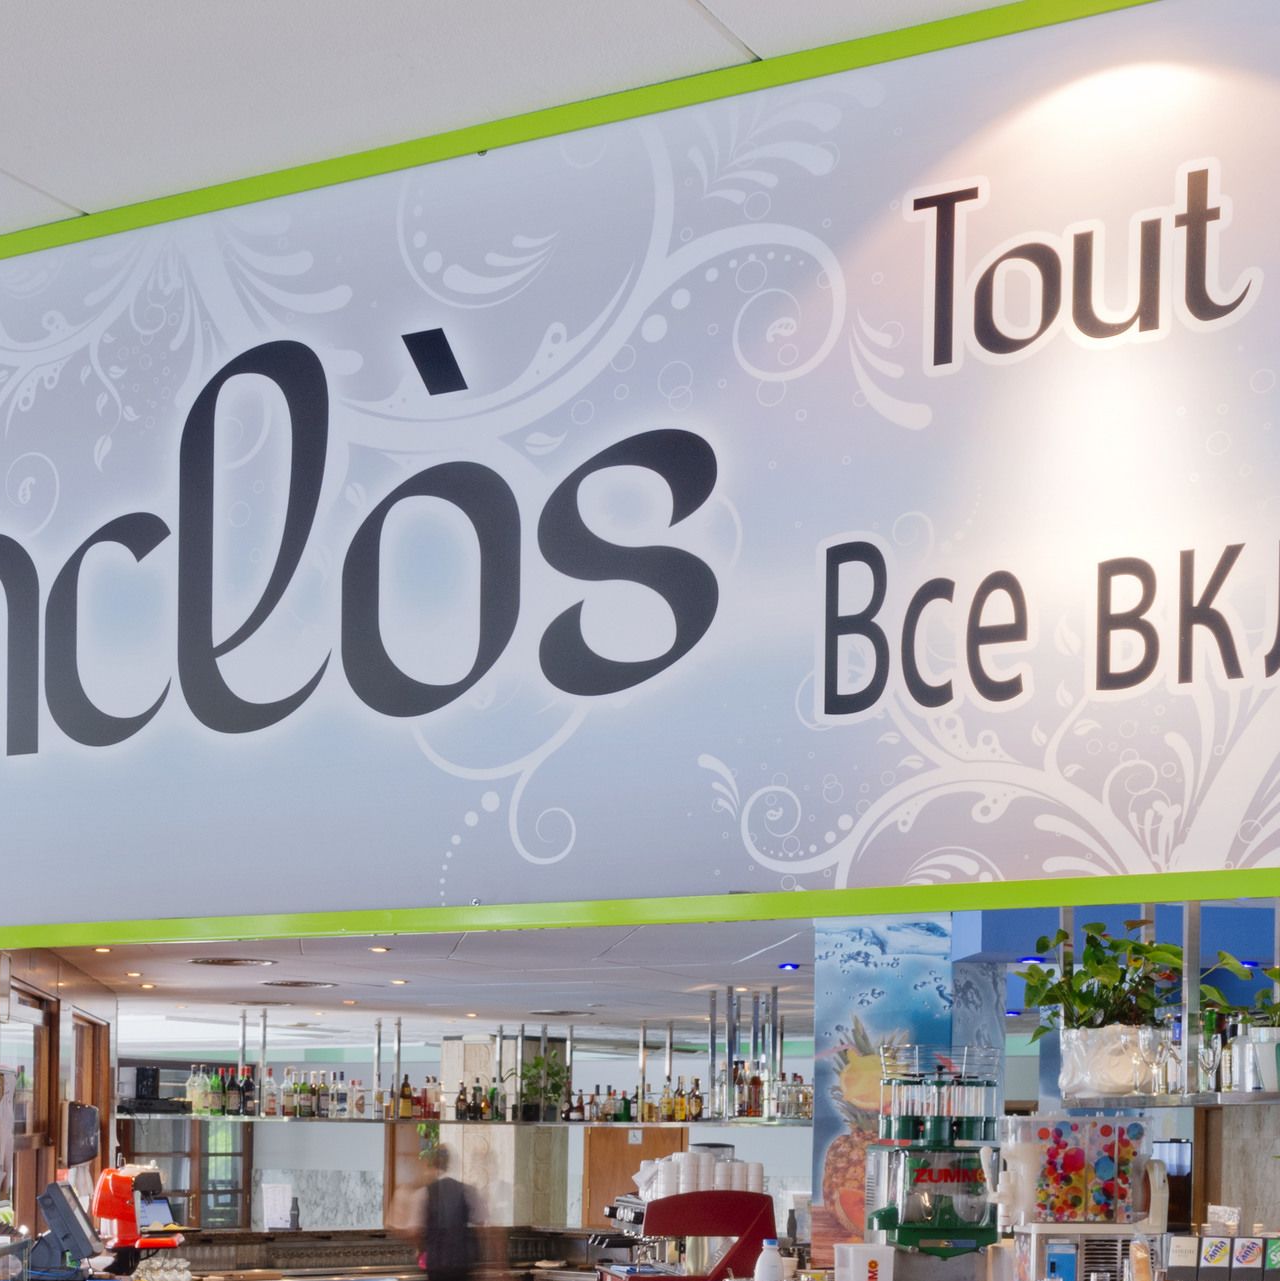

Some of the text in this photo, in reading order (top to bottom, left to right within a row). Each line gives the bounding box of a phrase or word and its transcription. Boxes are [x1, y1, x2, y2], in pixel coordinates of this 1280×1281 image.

[913, 168, 1251, 367] Tout
[823, 540, 1028, 716] Все
[1203, 1240, 1227, 1264] Fanta
[1235, 1241, 1259, 1264] Fanta
